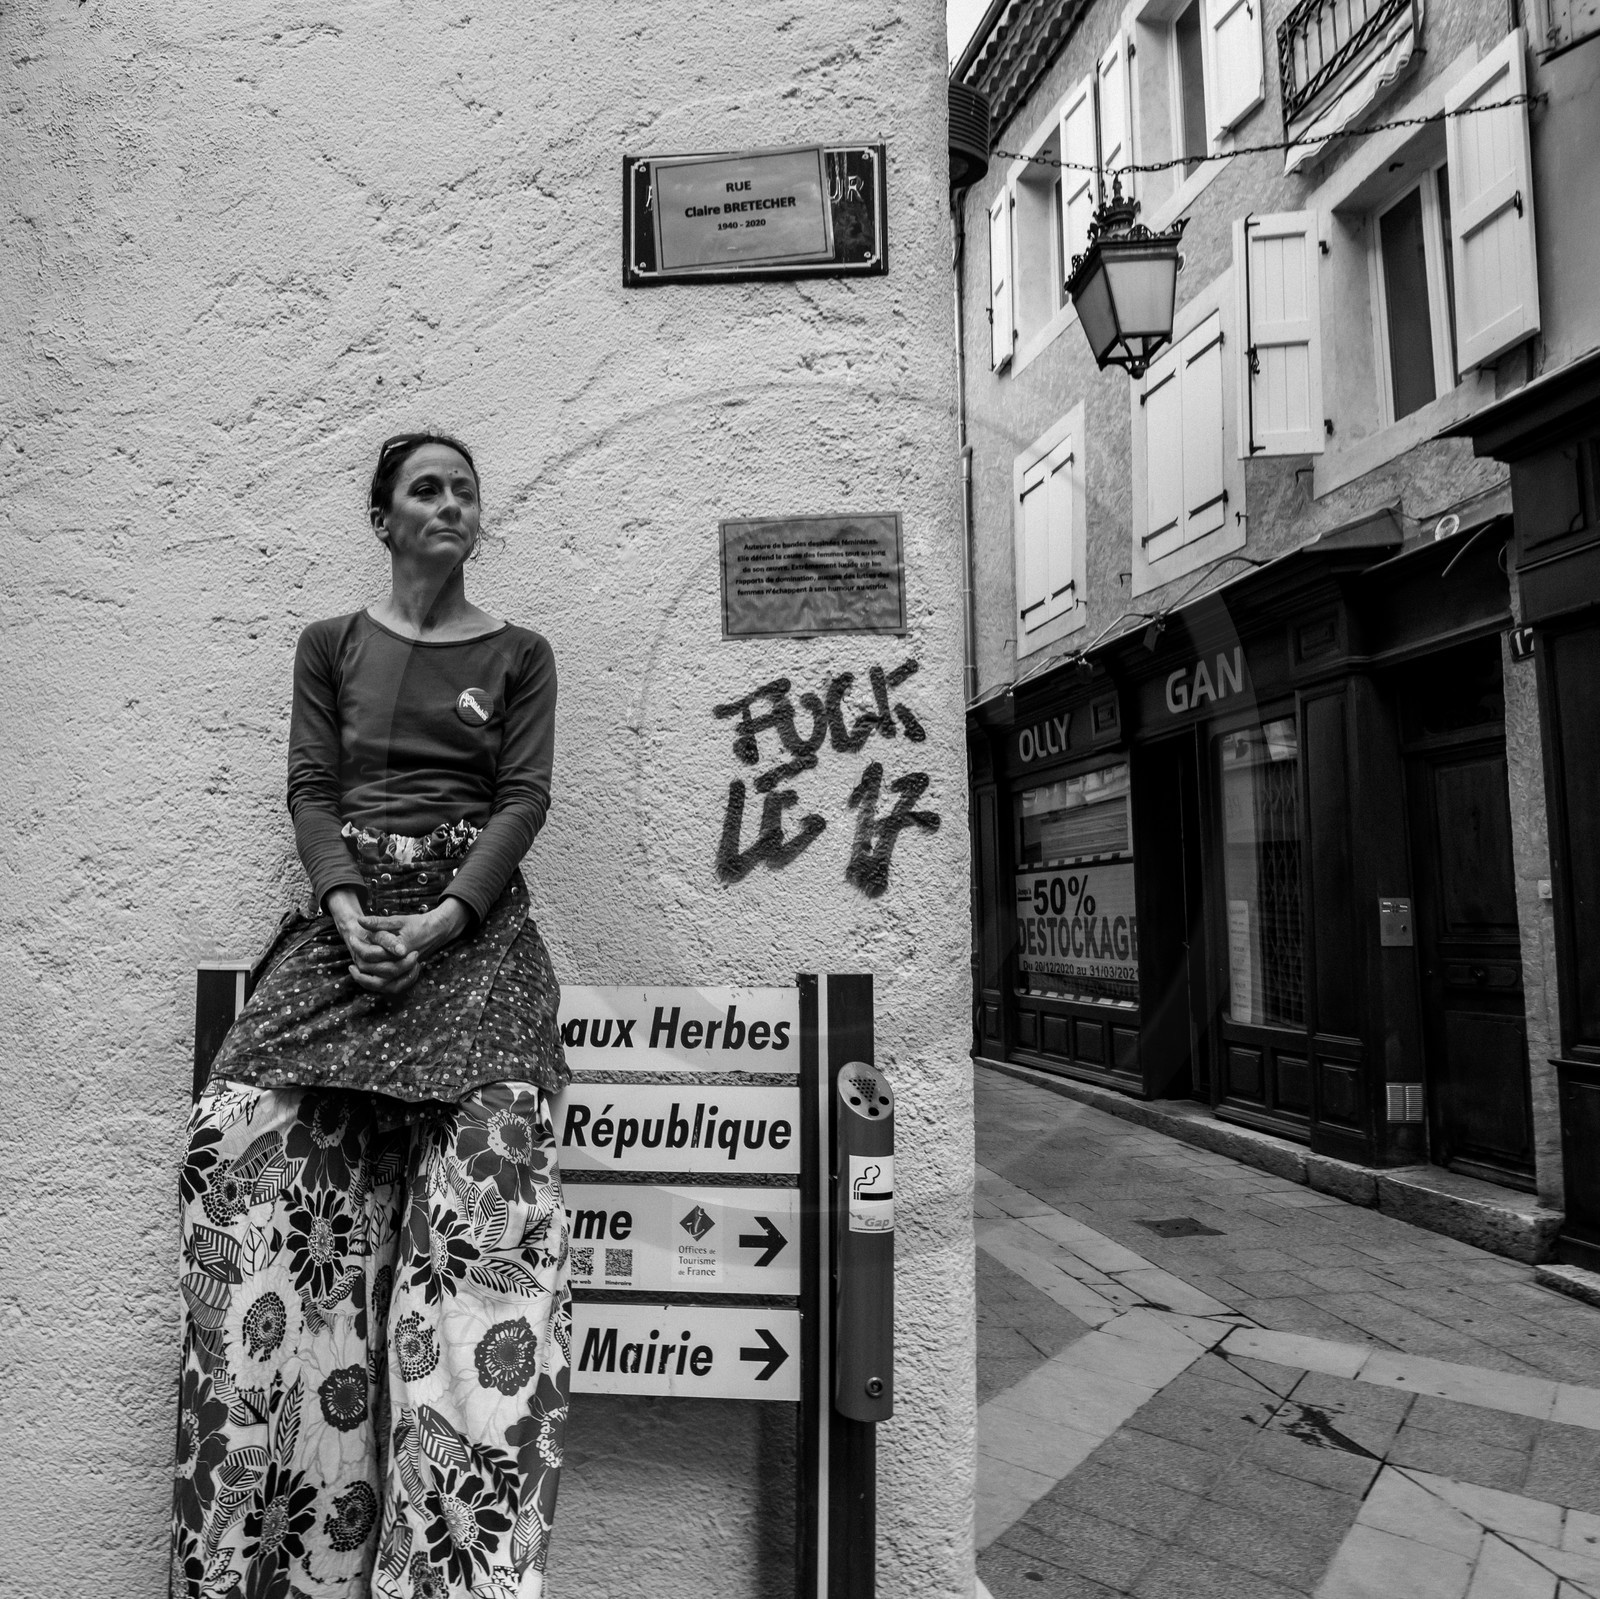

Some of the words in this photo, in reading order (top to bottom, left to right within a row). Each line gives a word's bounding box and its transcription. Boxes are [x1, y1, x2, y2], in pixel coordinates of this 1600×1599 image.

[725, 180, 752, 193] RUE
[684, 204, 721, 218] Claire
[723, 196, 796, 214] BRETECHER
[717, 221, 738, 231] 1940
[745, 218, 766, 228] 2020
[744, 543, 771, 551] Auteure
[782, 540, 807, 549] bandes
[807, 539, 840, 548] dessinées
[750, 553, 775, 562] défend
[783, 552, 802, 560] cause
[803, 551, 816, 559] des
[870, 549, 886, 557] long
[838, 560, 859, 569] lucide
[871, 559, 882, 567] les
[735, 577, 764, 586] rapports
[775, 574, 817, 583] domination,
[817, 573, 843, 581] aucune
[844, 572, 856, 580] des
[877, 571, 890, 579] des
[737, 588, 765, 596] femmes
[1019, 713, 1070, 763] OLLY
[1165, 646, 1243, 714] GAN
[713, 658, 926, 767] FUCK
[715, 754, 827, 885] LE
[1017, 916, 1139, 961] DESTOCKAGE
[1023, 960, 1033, 970] Du
[1034, 961, 1074, 975] 20/12/2020
[1077, 967, 1087, 976] au
[649, 1005, 792, 1051] Herbes
[562, 1103, 793, 1161] République
[864, 1217, 890, 1230] Gap
[678, 1245, 708, 1255] Offices
[678, 1255, 717, 1266] Tourisme
[687, 1266, 716, 1277] France
[577, 1327, 714, 1377] Mairie
